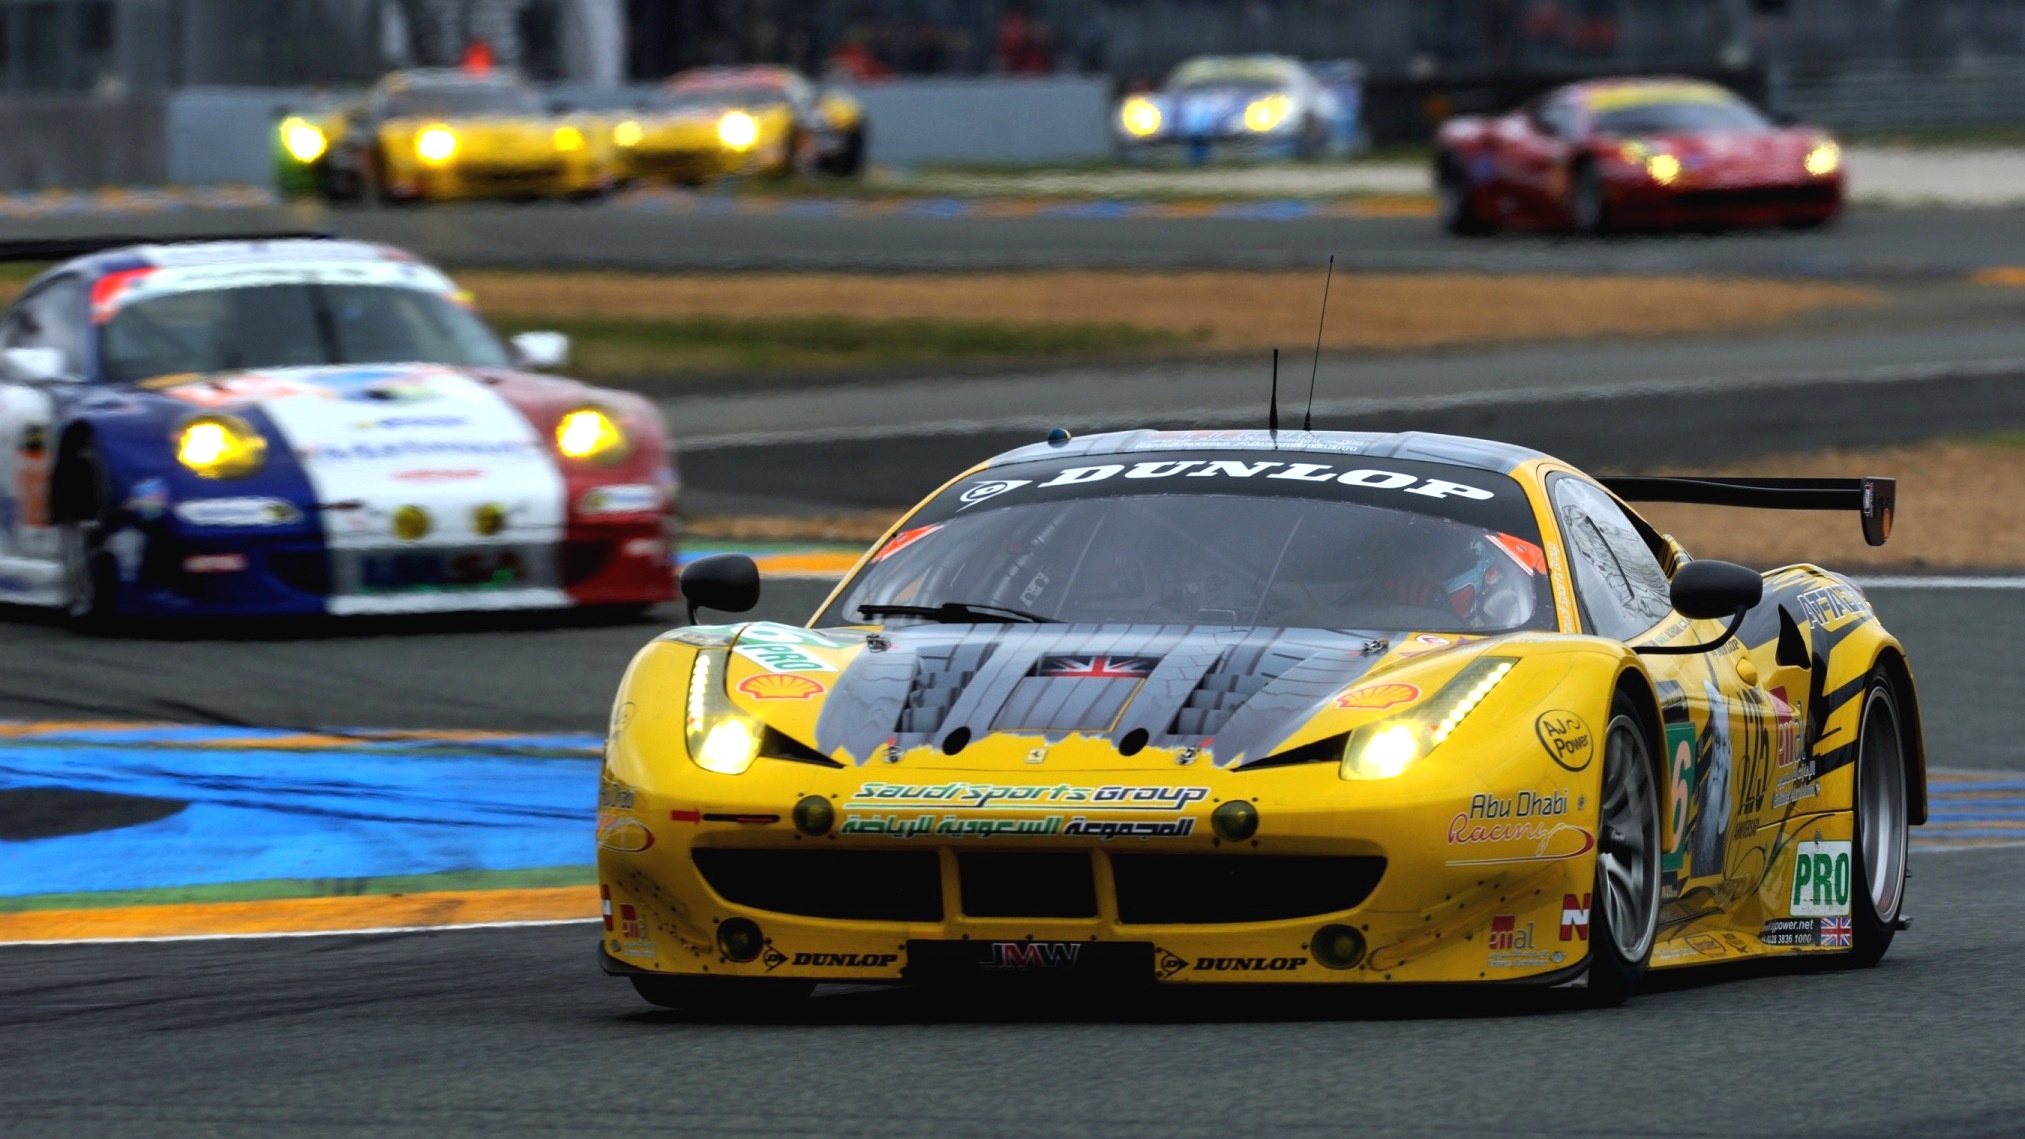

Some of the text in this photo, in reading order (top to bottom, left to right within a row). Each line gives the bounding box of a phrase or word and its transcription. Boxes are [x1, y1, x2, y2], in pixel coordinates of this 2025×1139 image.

[1037, 460, 1495, 500] DUNLOP
[742, 645, 824, 670] PRO
[1543, 718, 1568, 738] AJ
[1553, 734, 1589, 758] Power
[1093, 785, 1212, 811] Group
[1470, 789, 1569, 819] Abu Dhabi
[935, 815, 1064, 838] السعودية
[1063, 816, 1197, 839] المجموعة
[1446, 813, 1567, 858] Racing
[1793, 853, 1849, 906] PRO
[1489, 921, 1535, 950] emal
[1795, 933, 1812, 944] 1000
[792, 953, 898, 967] DUNLOP
[979, 943, 1081, 968] JMW
[1193, 957, 1308, 971] DUNLOP
